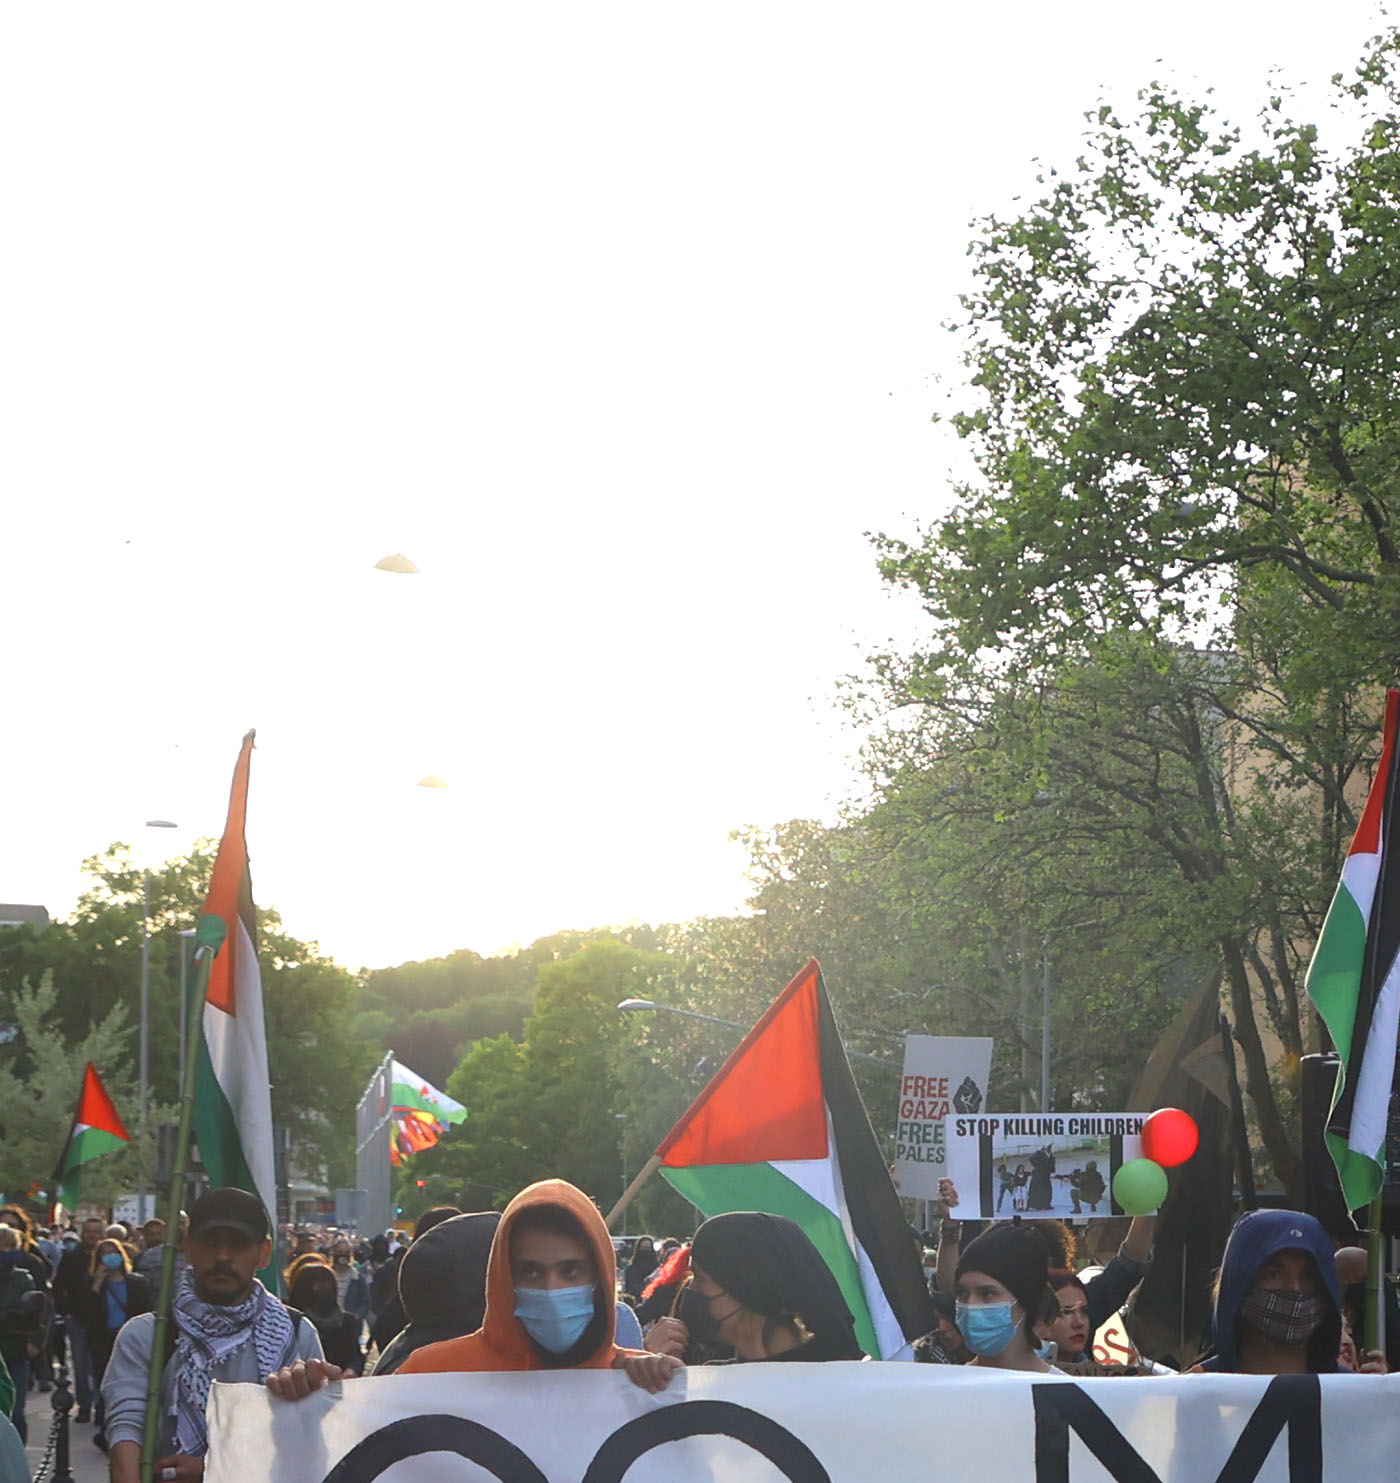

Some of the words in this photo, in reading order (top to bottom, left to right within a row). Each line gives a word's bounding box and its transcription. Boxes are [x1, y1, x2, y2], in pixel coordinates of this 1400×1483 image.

[902, 1075, 949, 1100] FREE
[901, 1099, 950, 1121] GAZA
[898, 1121, 945, 1145] FREE
[956, 1118, 1000, 1137] STOP
[1004, 1118, 1064, 1136] KILLING
[1068, 1117, 1143, 1136] CHILDREN
